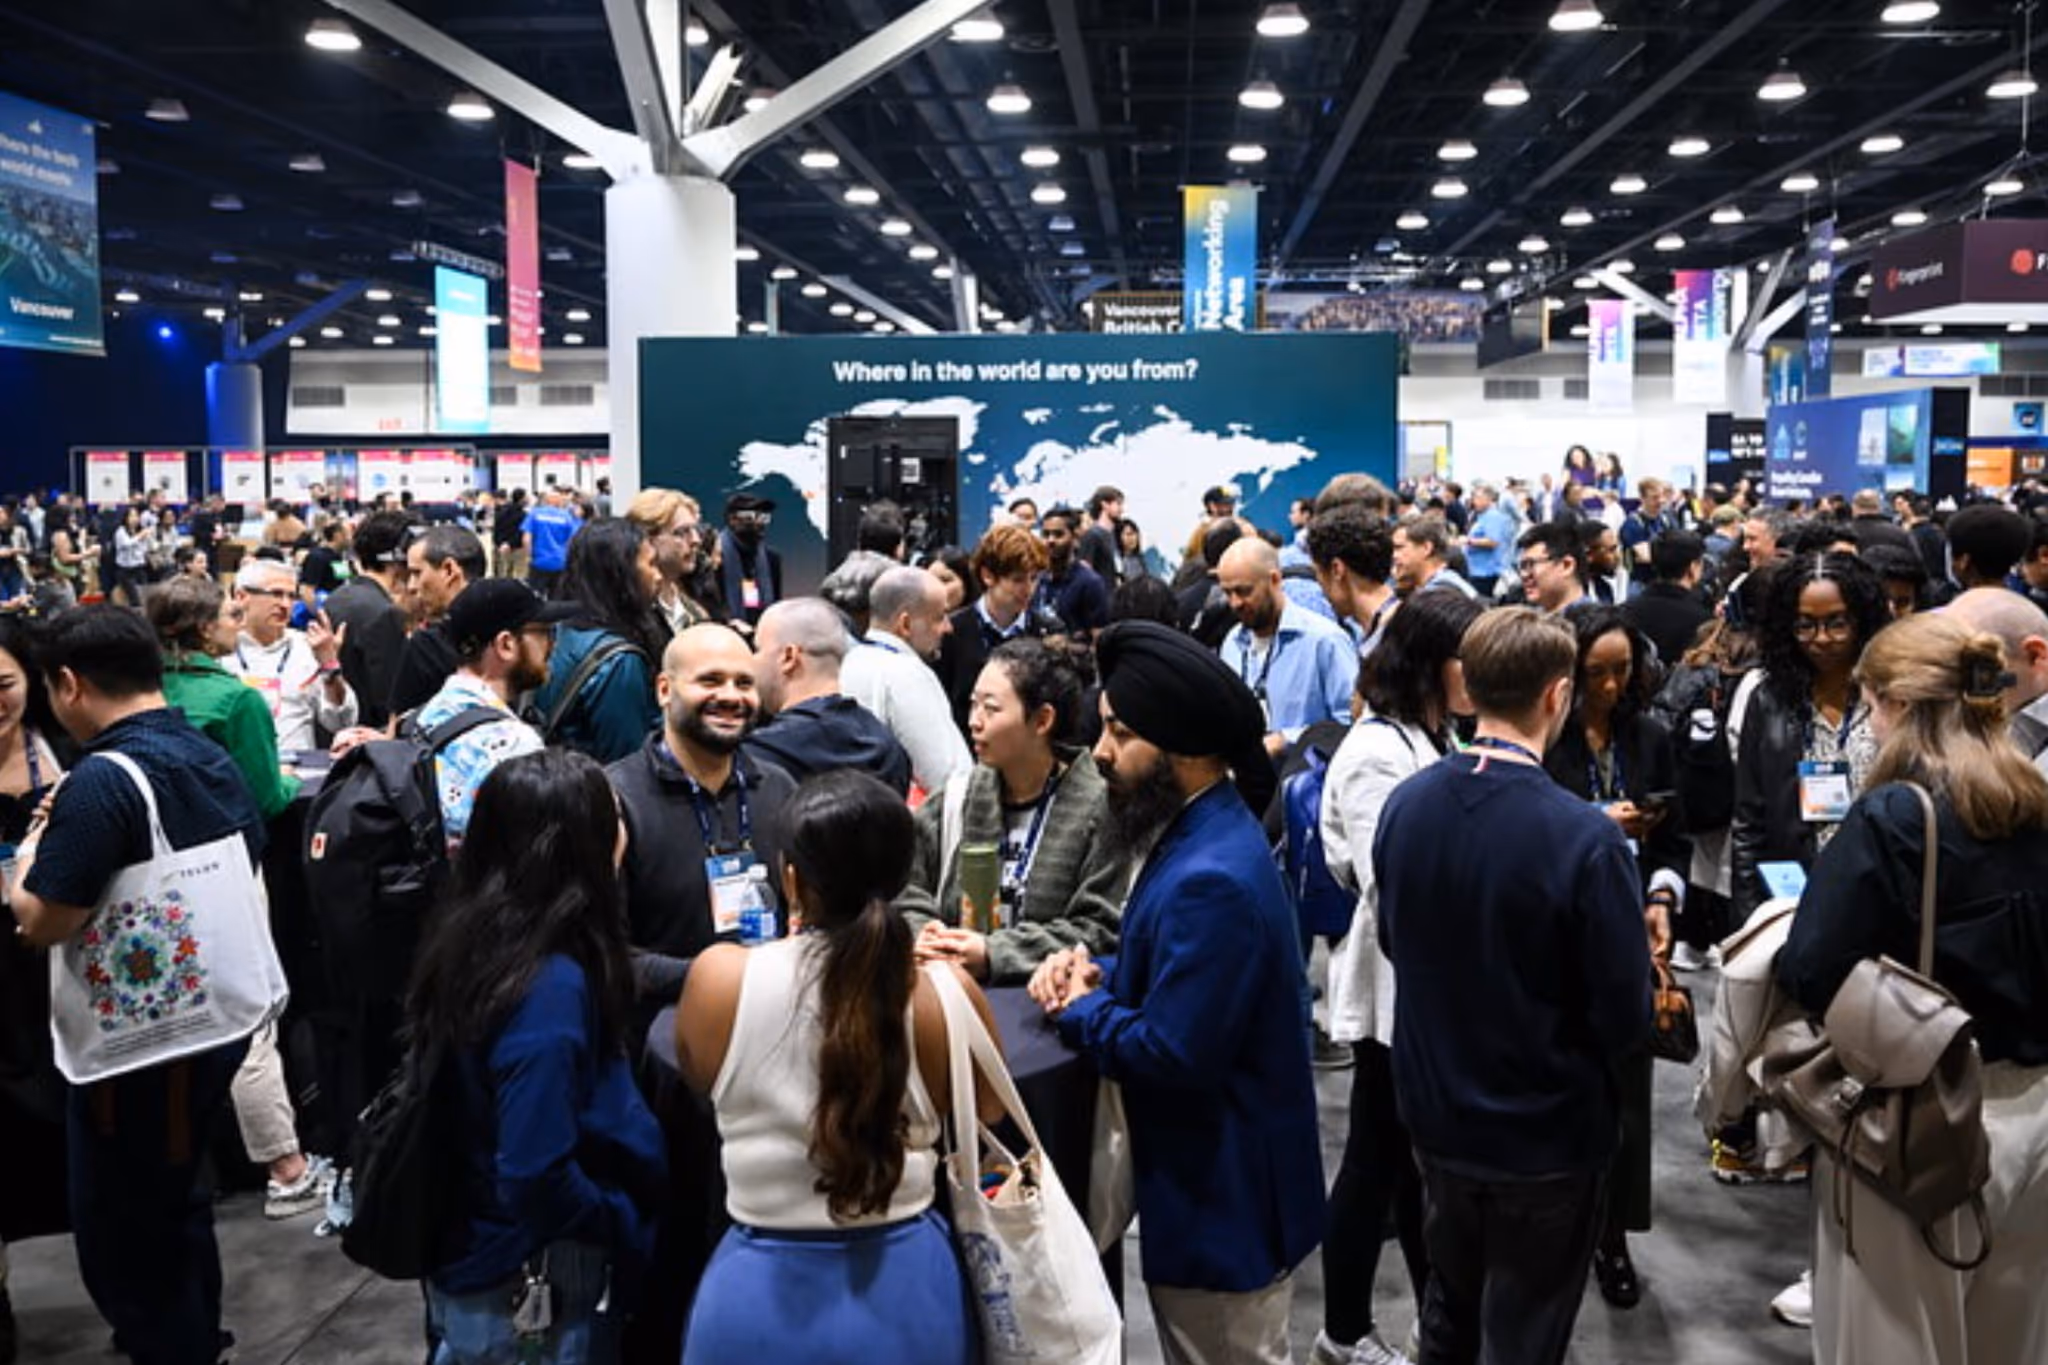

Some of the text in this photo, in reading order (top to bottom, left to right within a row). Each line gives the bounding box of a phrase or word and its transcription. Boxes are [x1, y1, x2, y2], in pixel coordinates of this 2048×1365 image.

[0, 133, 30, 155] here
[1202, 200, 1246, 332] Networking Area
[9, 296, 75, 320] Vancouver
[1103, 302, 1180, 317] Vancouver
[1103, 320, 1162, 335] British
[832, 357, 1200, 386] Where in the world are you from?
